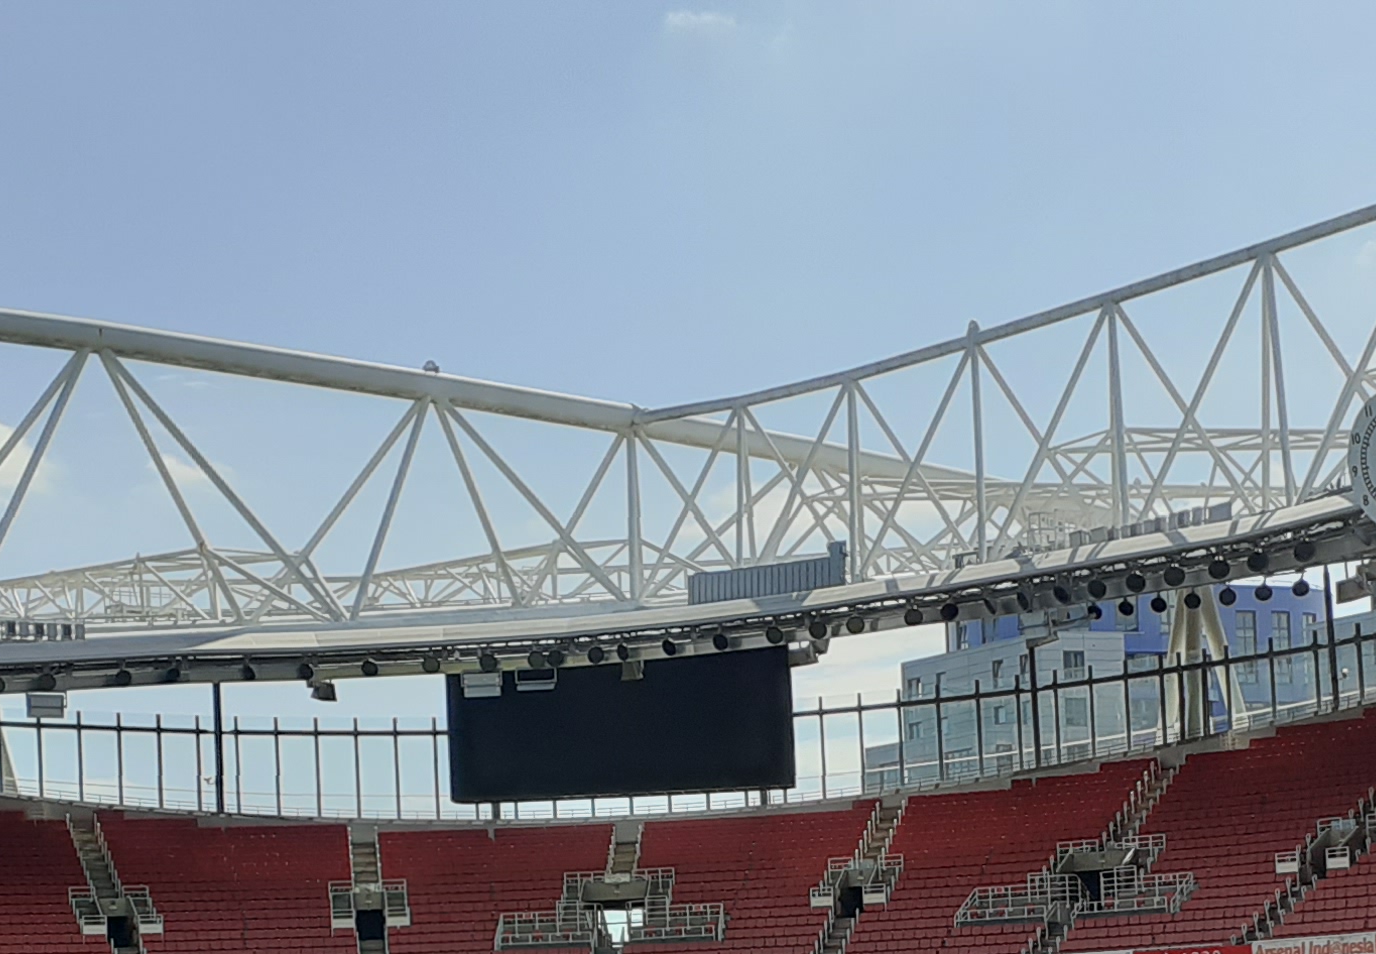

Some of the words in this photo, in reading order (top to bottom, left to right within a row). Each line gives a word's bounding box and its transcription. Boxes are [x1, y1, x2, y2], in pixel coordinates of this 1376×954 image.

[1364, 405, 1372, 417] 11
[1351, 433, 1361, 445] 10
[1352, 465, 1358, 477] 9
[1362, 494, 1369, 506] 8
